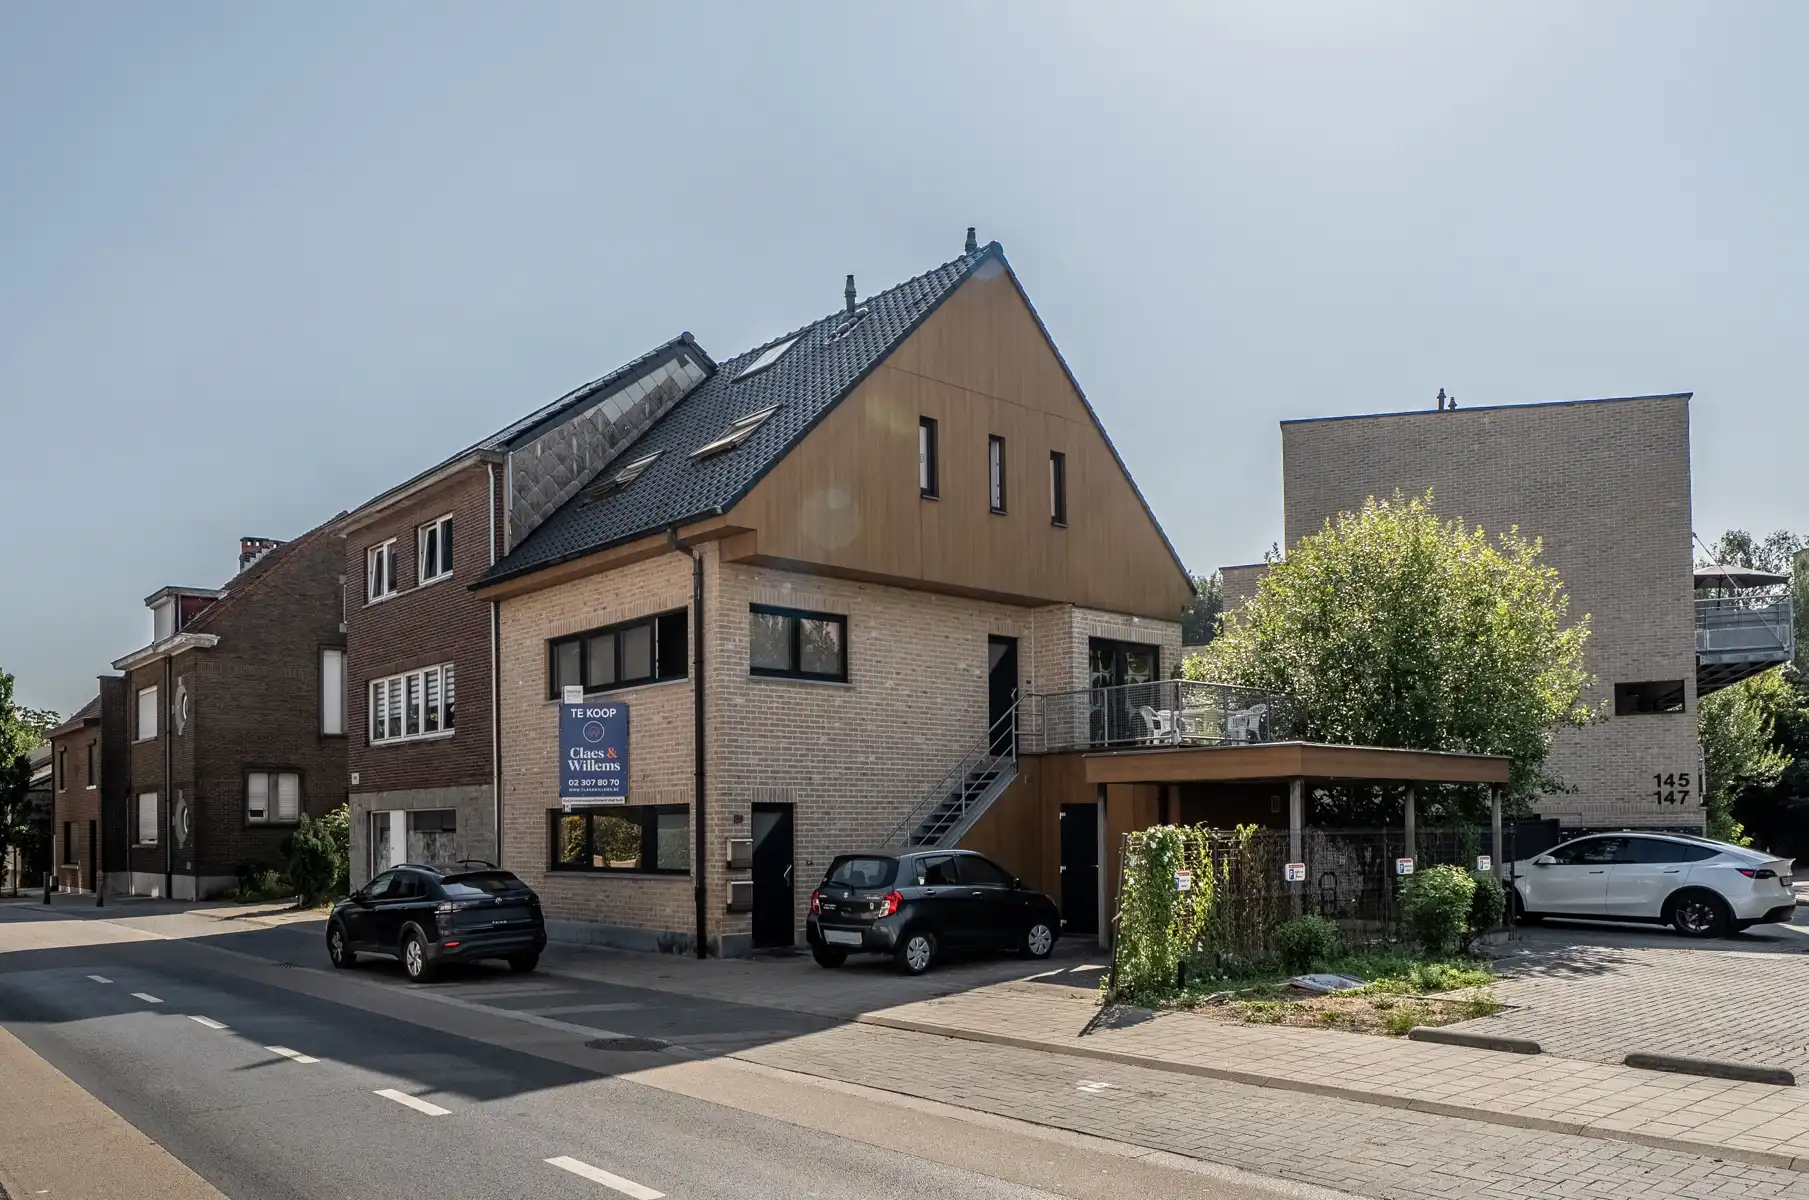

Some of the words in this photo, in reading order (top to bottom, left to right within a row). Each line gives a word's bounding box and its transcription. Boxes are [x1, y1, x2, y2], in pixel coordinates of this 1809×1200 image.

[570, 708, 584, 718] TE
[586, 708, 617, 718] KOOP
[570, 747, 605, 759] Claes
[607, 747, 618, 759] &
[568, 760, 621, 771] Willems
[1653, 773, 1690, 788] 145
[1653, 790, 1690, 805] 147
